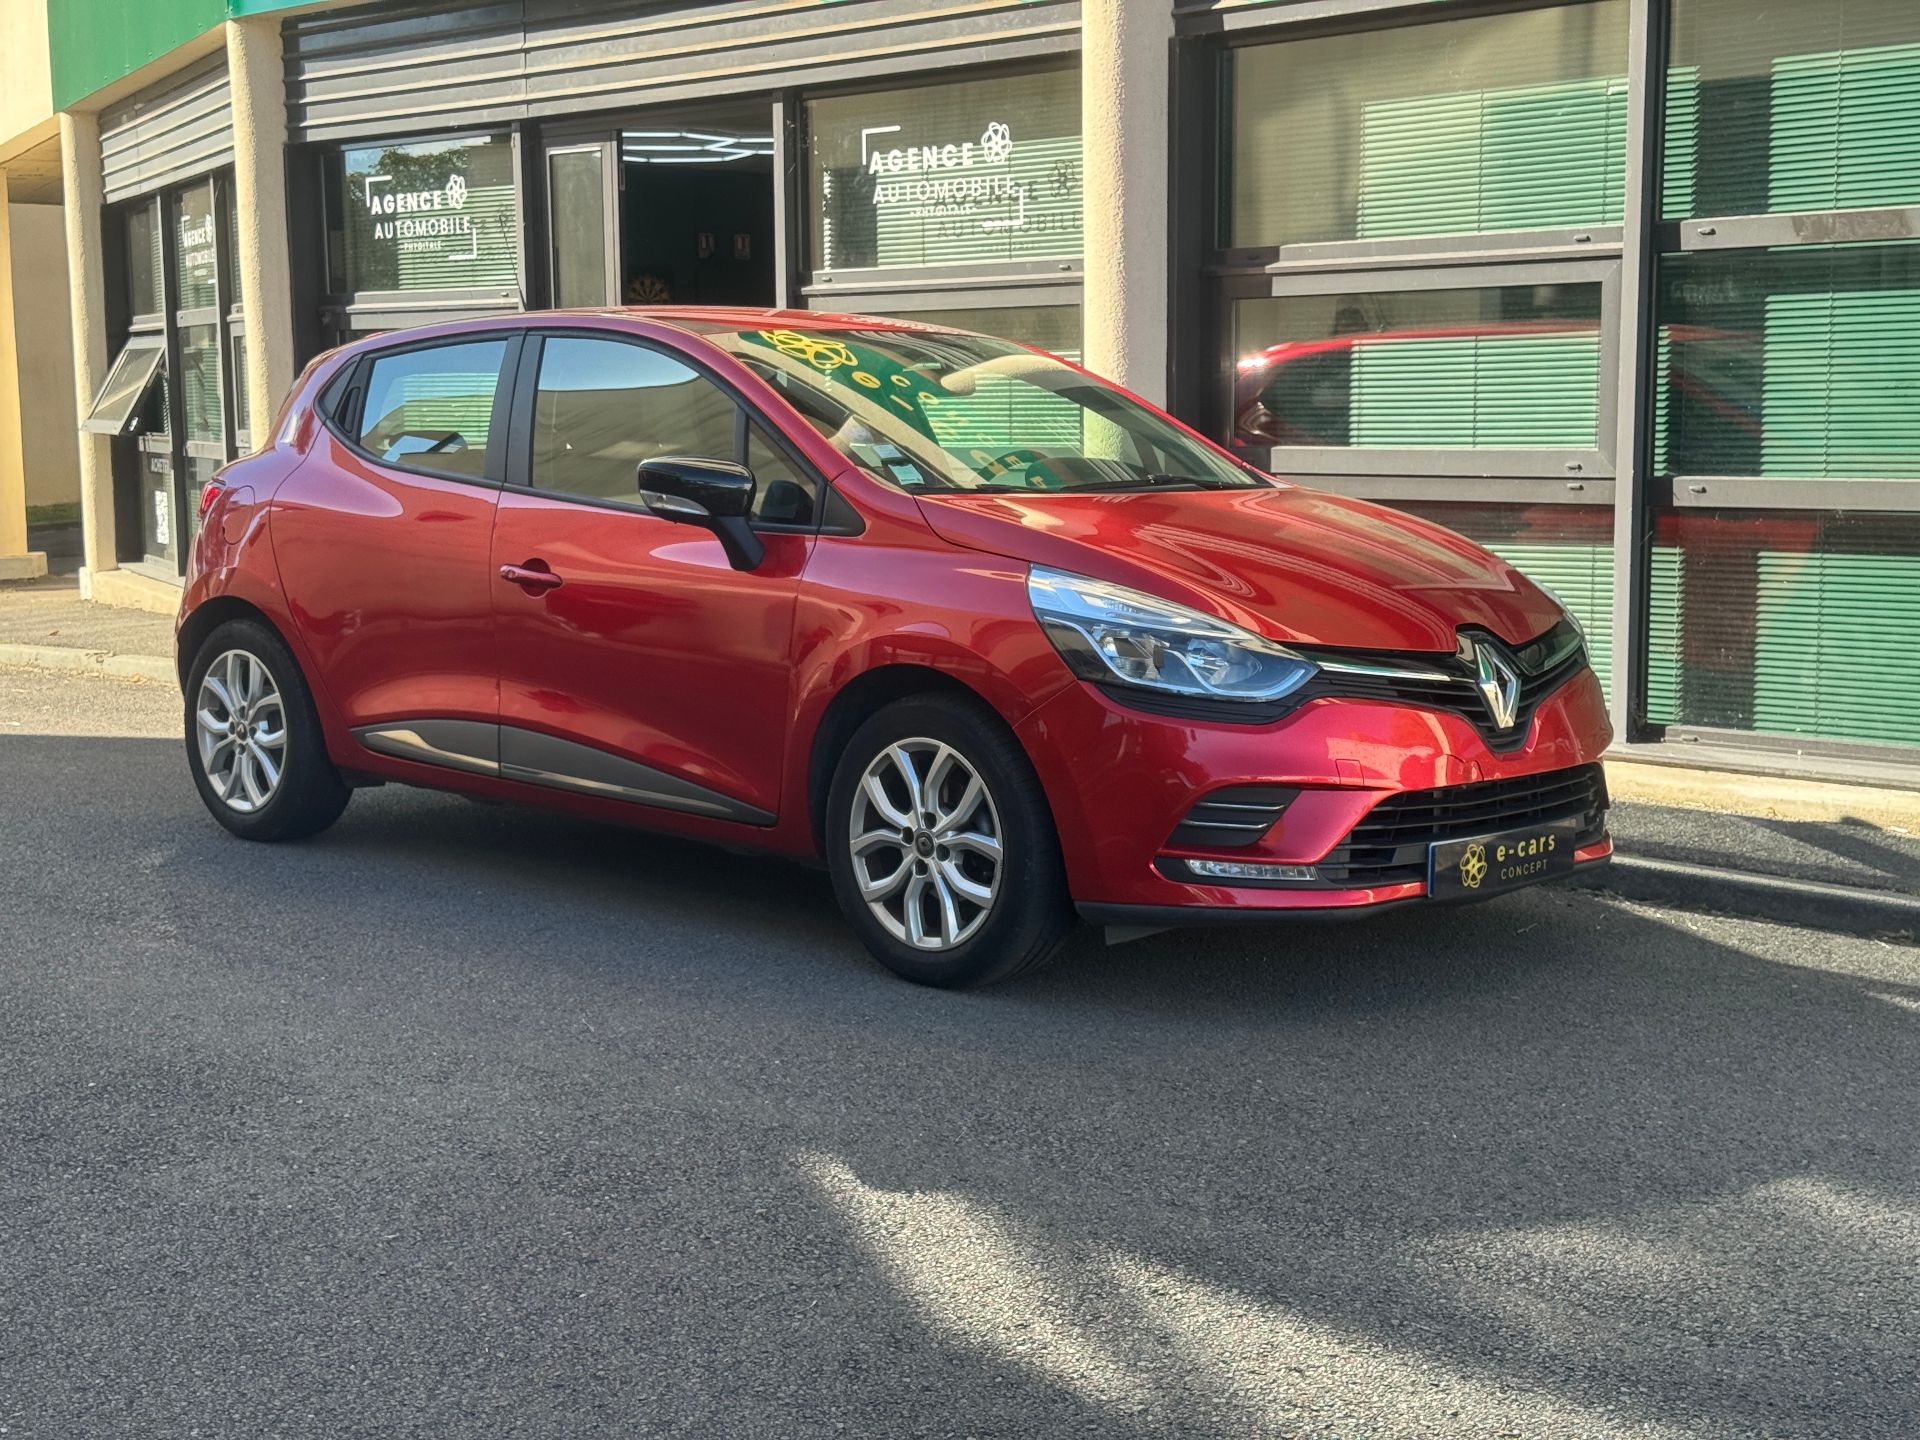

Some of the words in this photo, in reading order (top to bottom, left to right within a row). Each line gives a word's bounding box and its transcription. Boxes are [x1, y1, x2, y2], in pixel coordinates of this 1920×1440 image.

[868, 142, 974, 175] AGENCE
[371, 190, 443, 215] AGENCE
[873, 176, 1015, 204] AUTOMOBILE
[374, 216, 471, 240] AUTOMOBILE
[1496, 833, 1556, 862] e-cars
[1500, 859, 1548, 880] CONCEPT
